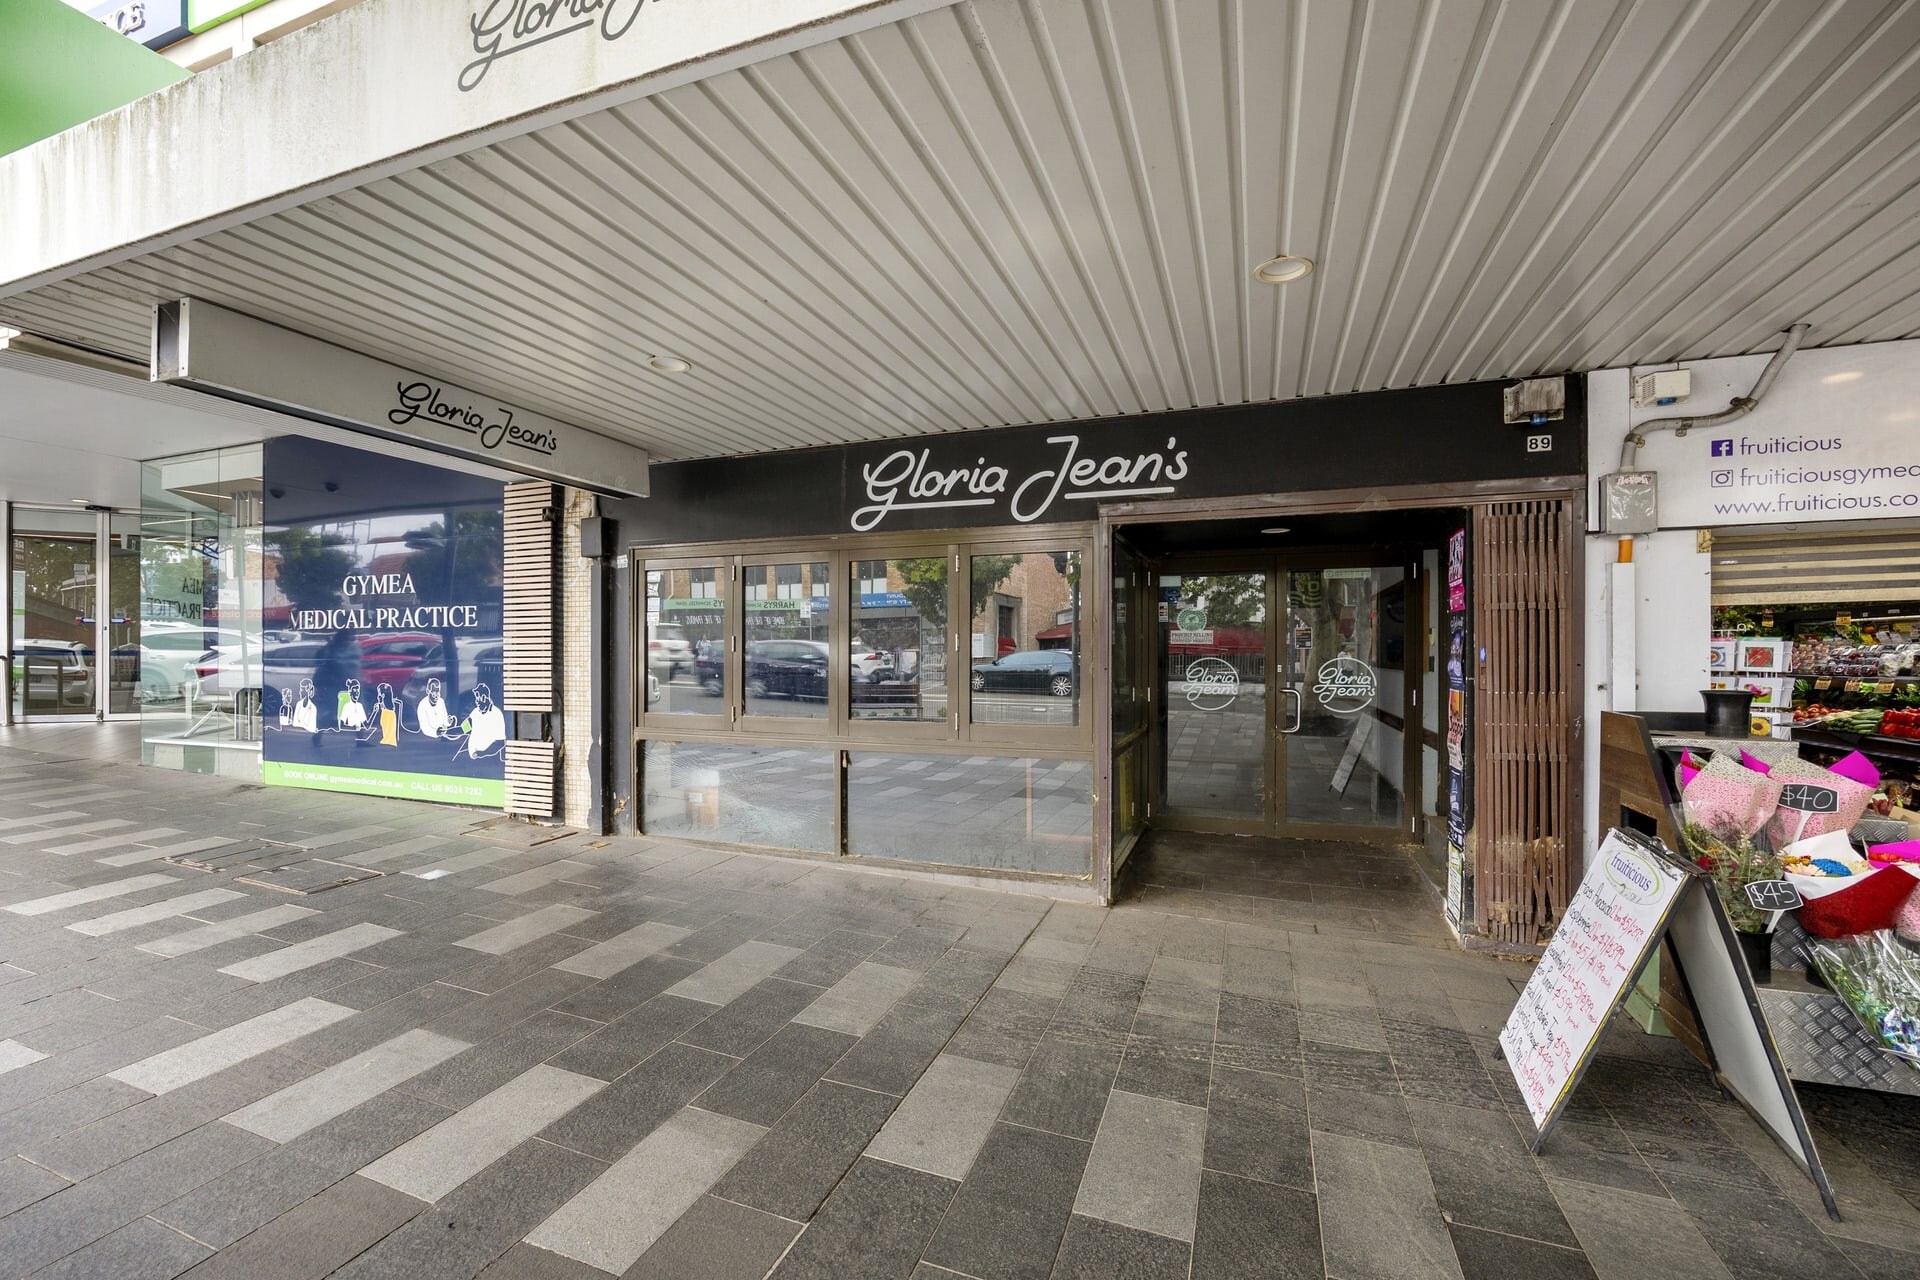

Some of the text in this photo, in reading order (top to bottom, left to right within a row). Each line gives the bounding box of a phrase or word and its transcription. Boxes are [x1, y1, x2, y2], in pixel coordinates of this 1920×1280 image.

[388, 381, 558, 455] Gloria Jean's
[1528, 437, 1551, 451] 89
[1740, 436, 1842, 456] fruiticious
[851, 435, 1188, 532] Gloria Jean's
[342, 573, 417, 597] GYMEA
[288, 608, 372, 631] MEDICAL
[375, 605, 479, 629] PRACTICE
[1181, 667, 1235, 692] Gloria
[1313, 668, 1371, 693] Gloria
[411, 782, 430, 791] CALL
[432, 784, 443, 792] US
[1781, 785, 1833, 809] $40
[1611, 852, 1652, 892] fruiticious
[1750, 881, 1796, 905] $45
